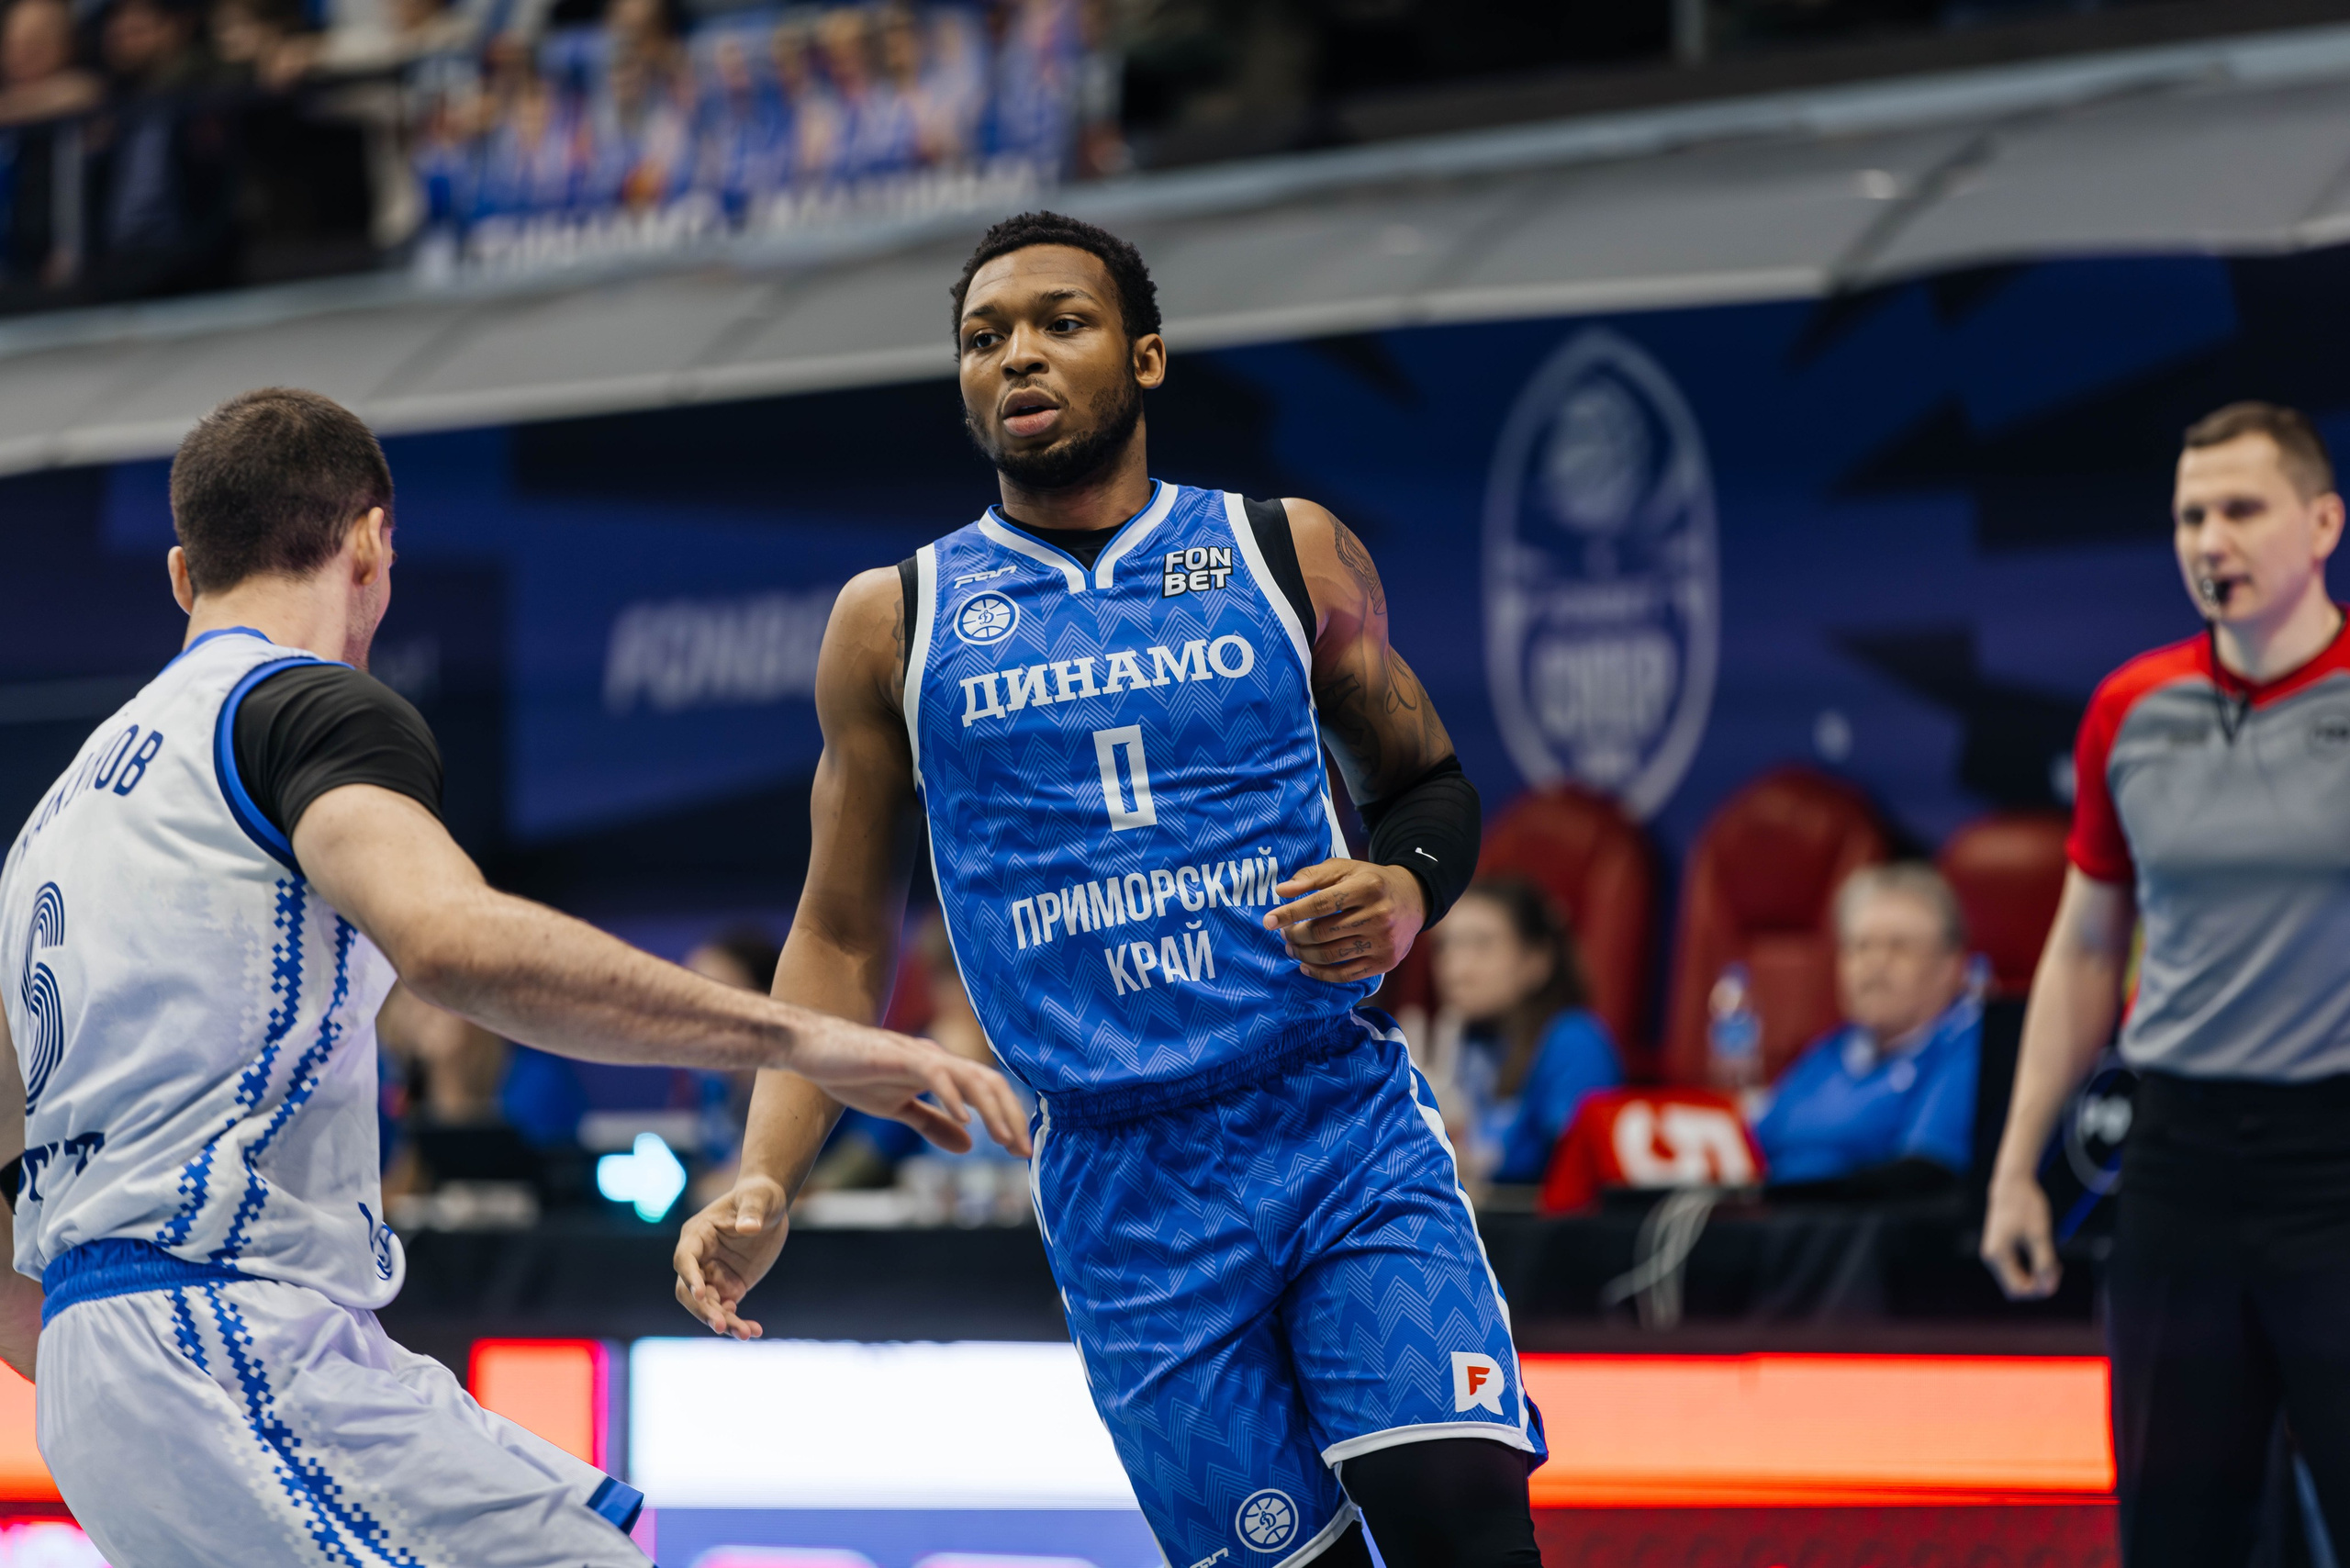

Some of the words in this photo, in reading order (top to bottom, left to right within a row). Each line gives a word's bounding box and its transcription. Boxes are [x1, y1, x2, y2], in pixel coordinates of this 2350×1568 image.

[1163, 567, 1233, 597] BET
[1164, 546, 1233, 574] FON
[959, 635, 1254, 727] ДИНАМО
[1092, 724, 1158, 832] 0
[1012, 846, 1281, 950] ПРИМОРСКИЙ
[1104, 918, 1215, 995] КРАЙ
